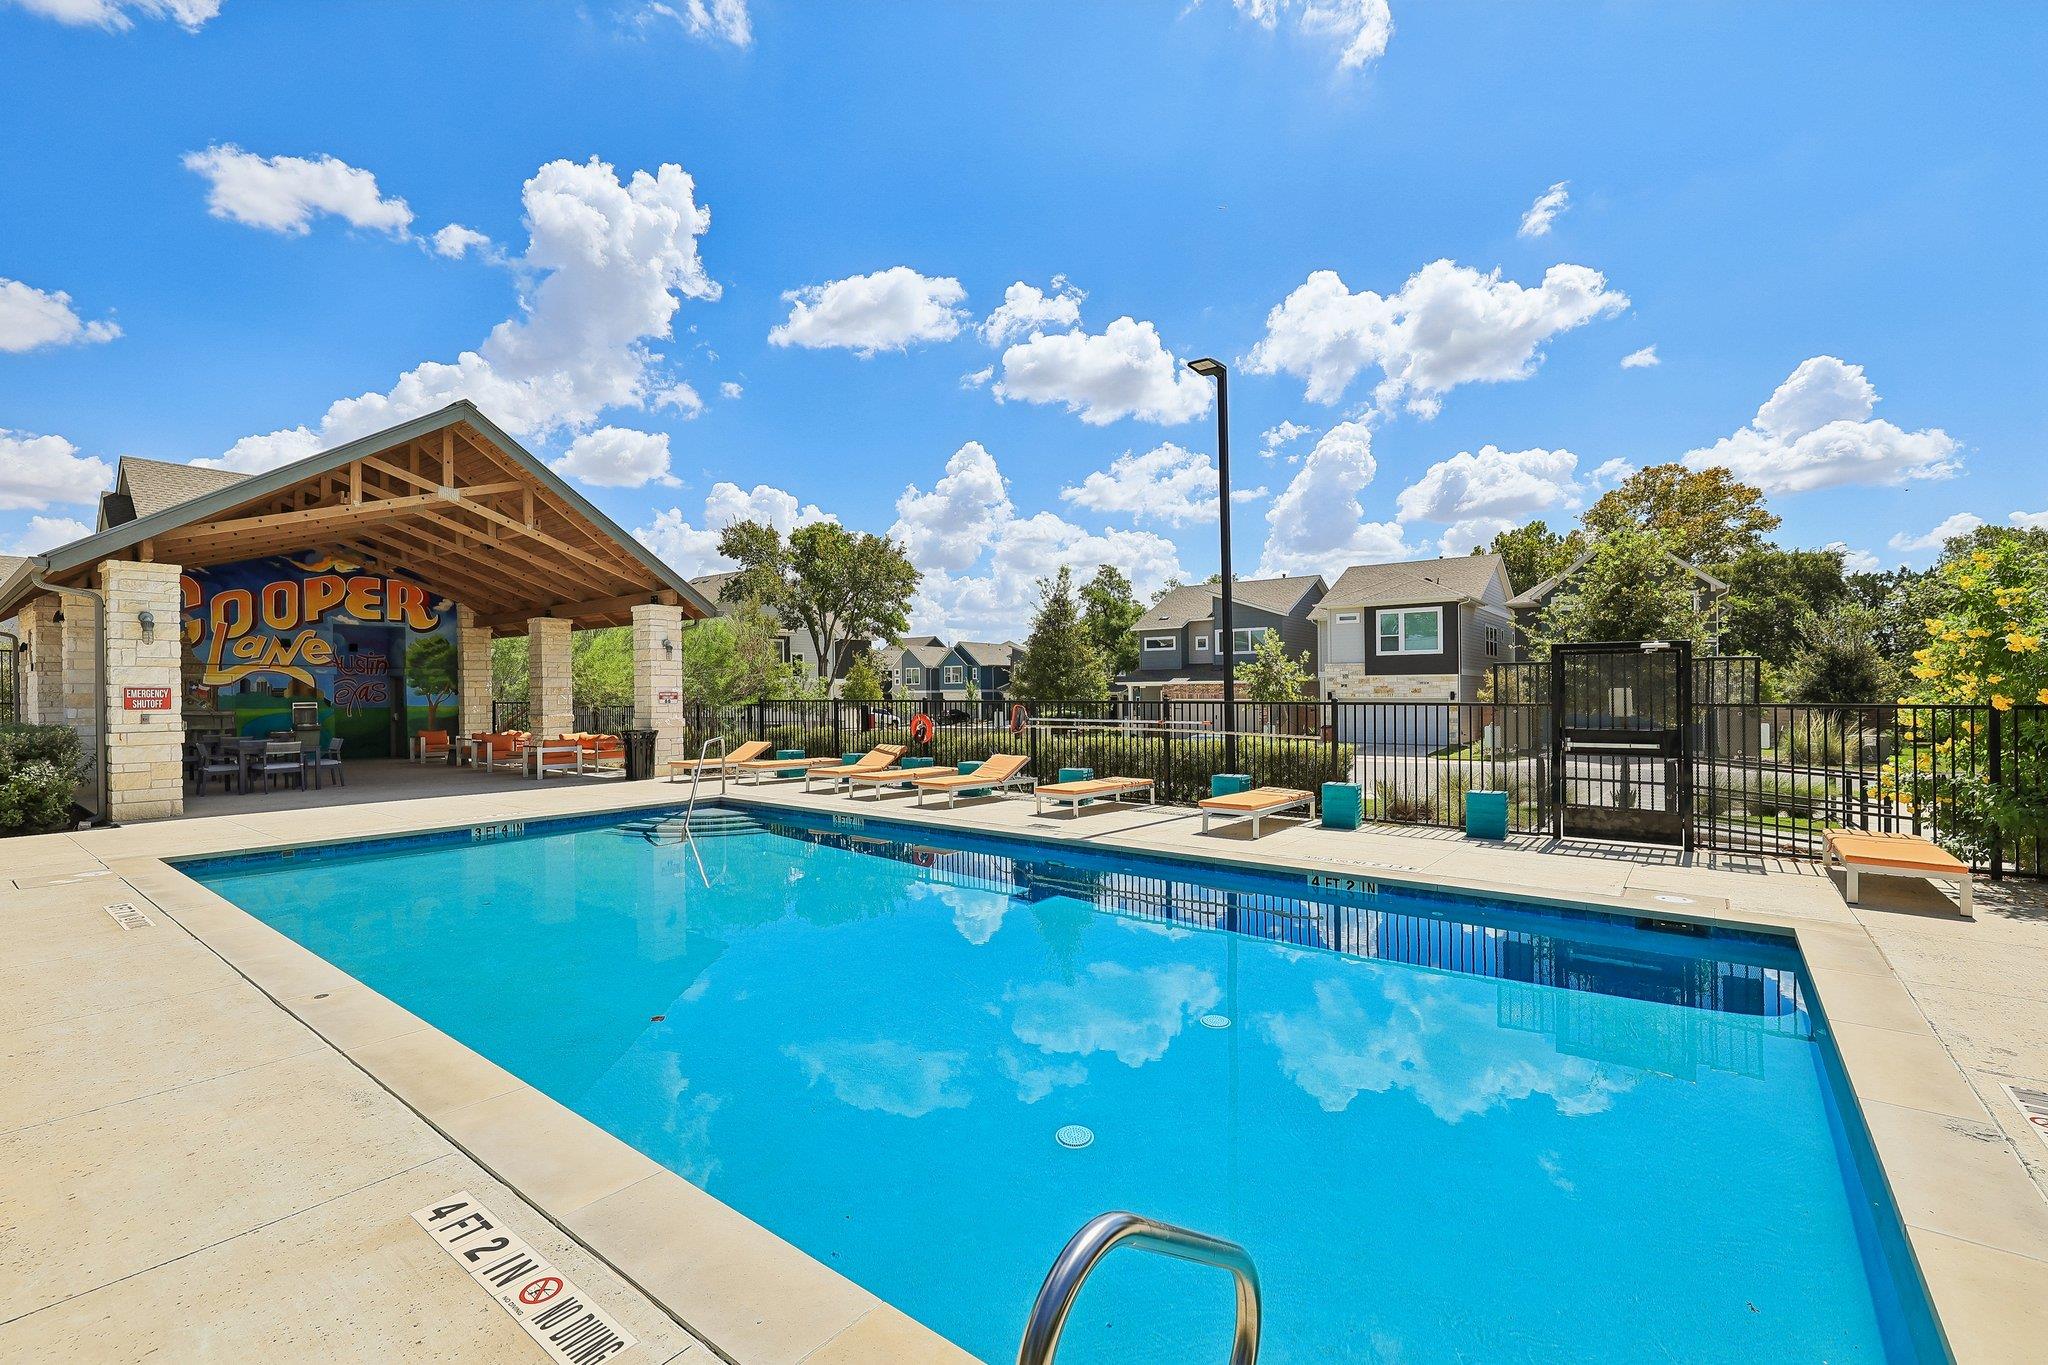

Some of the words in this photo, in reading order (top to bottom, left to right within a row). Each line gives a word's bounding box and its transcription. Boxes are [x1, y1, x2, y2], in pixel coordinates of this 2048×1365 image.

[126, 689, 169, 698] EMERGENCY
[132, 699, 163, 708] SHUTOFF
[475, 828, 482, 836] 3
[486, 826, 497, 834] FT
[502, 824, 508, 832] 4
[513, 823, 523, 832] IN
[1311, 876, 1320, 886] 4
[1325, 878, 1340, 889] FT
[1346, 880, 1355, 891] 2
[1362, 882, 1376, 893] IN
[427, 1201, 469, 1222] 4
[438, 1212, 494, 1243] FT
[462, 1237, 510, 1263] 2
[482, 1252, 540, 1288] IN
[531, 1296, 584, 1331] NO
[548, 1313, 625, 1365] DIVING
